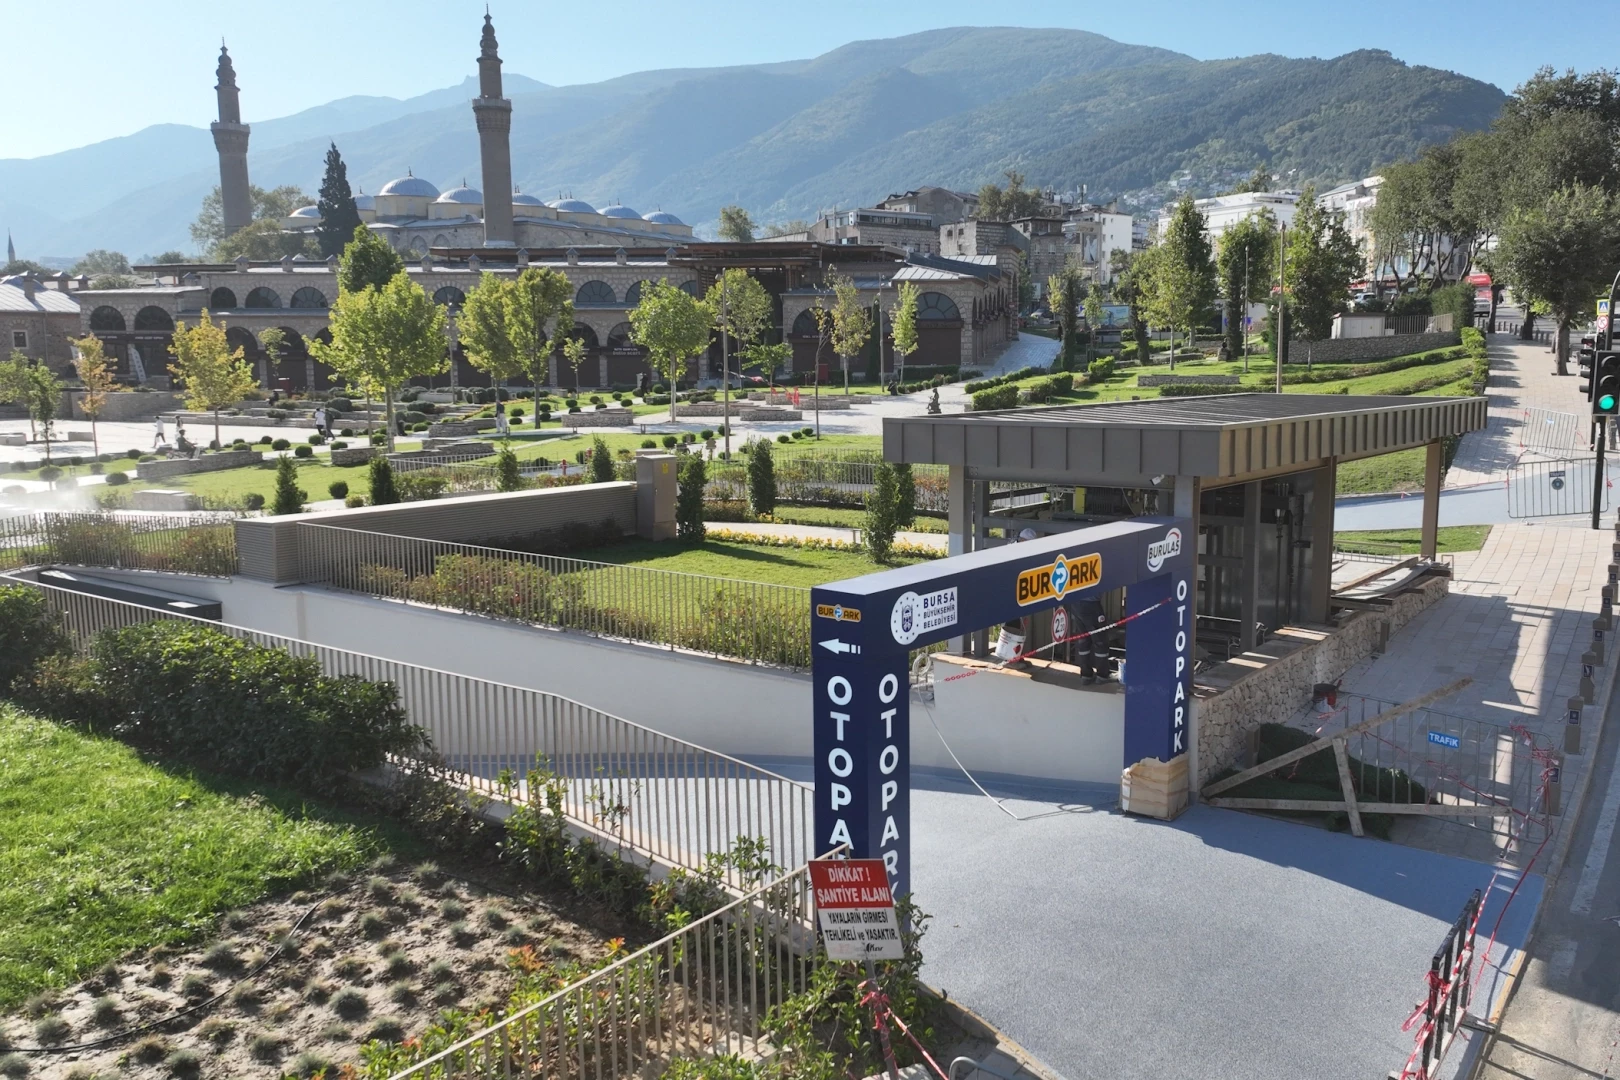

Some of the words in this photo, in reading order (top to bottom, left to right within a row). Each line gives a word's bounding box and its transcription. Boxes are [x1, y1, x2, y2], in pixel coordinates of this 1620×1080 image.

[1149, 540, 1180, 560] BURULAŞ
[923, 591, 955, 609] BURSA
[923, 614, 956, 630] BELEDİYESİ
[1174, 580, 1188, 753] OTOPARK
[828, 864, 864, 883] DİKKAT
[817, 885, 860, 907] ŞANTİYE
[861, 887, 890, 903] ALANI
[828, 911, 862, 924] YAYALARIN
[862, 909, 889, 924] GİRMESİ
[825, 927, 857, 941] TEHLİKELİ
[857, 932, 865, 940] ve
